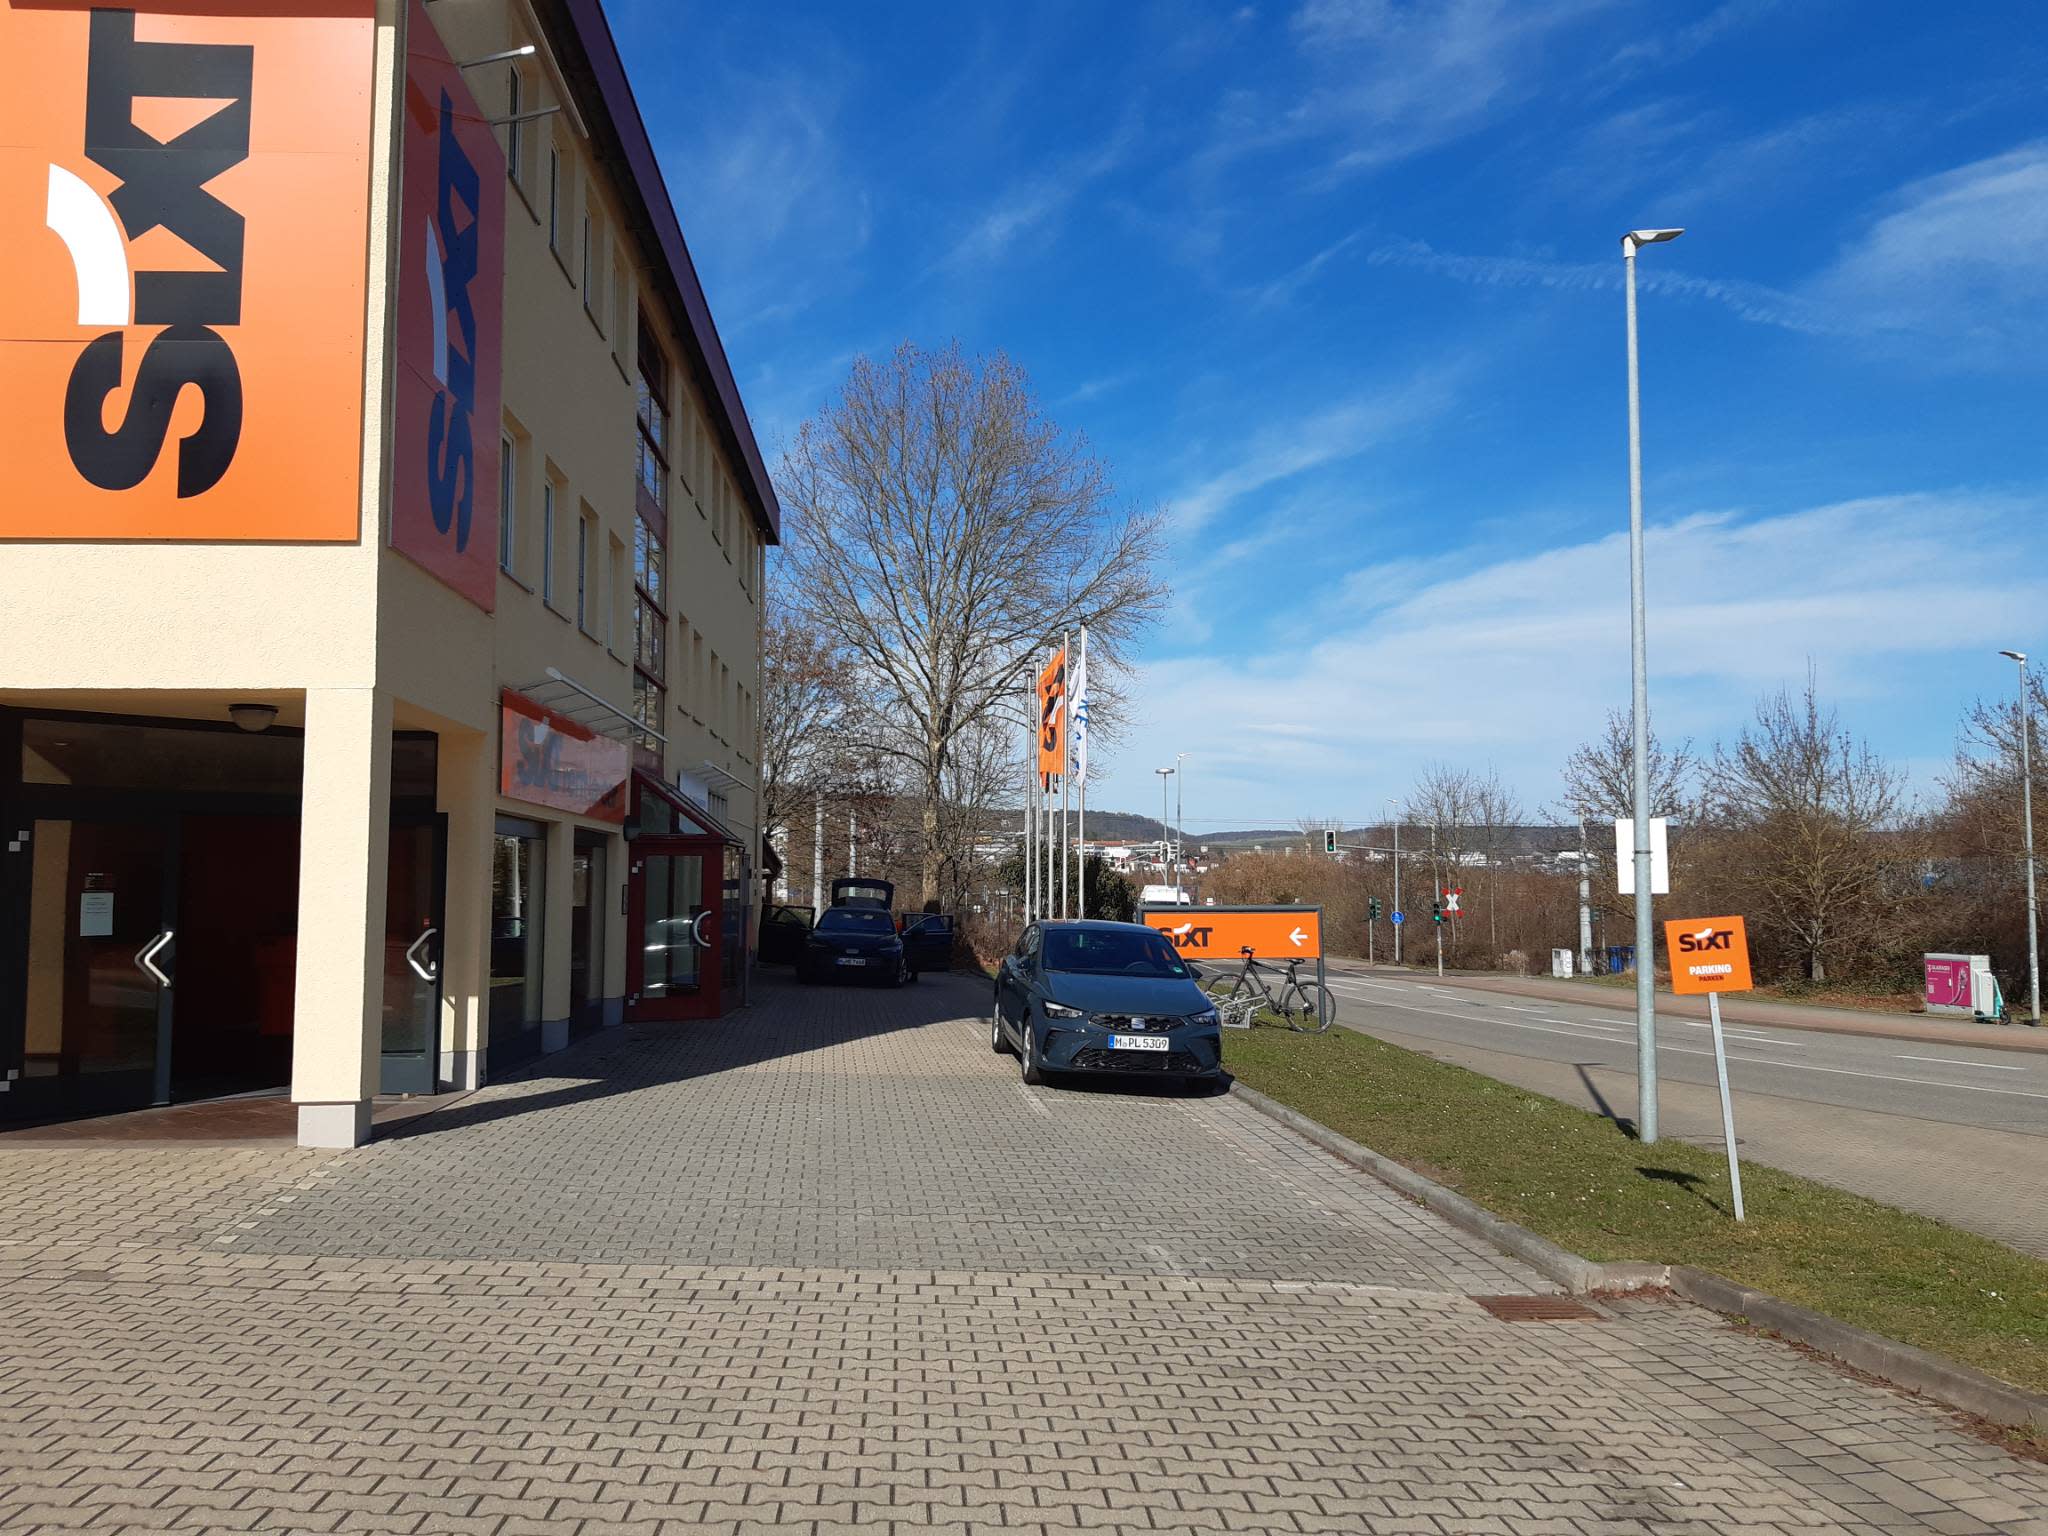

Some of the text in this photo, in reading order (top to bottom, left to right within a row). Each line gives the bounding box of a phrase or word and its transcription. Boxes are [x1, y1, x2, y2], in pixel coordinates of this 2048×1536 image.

[46, 7, 254, 499] SIXT
[1678, 928, 1734, 952] SIXT
[1689, 964, 1732, 975] PARKING
[1143, 1038, 1168, 1049] 5309
